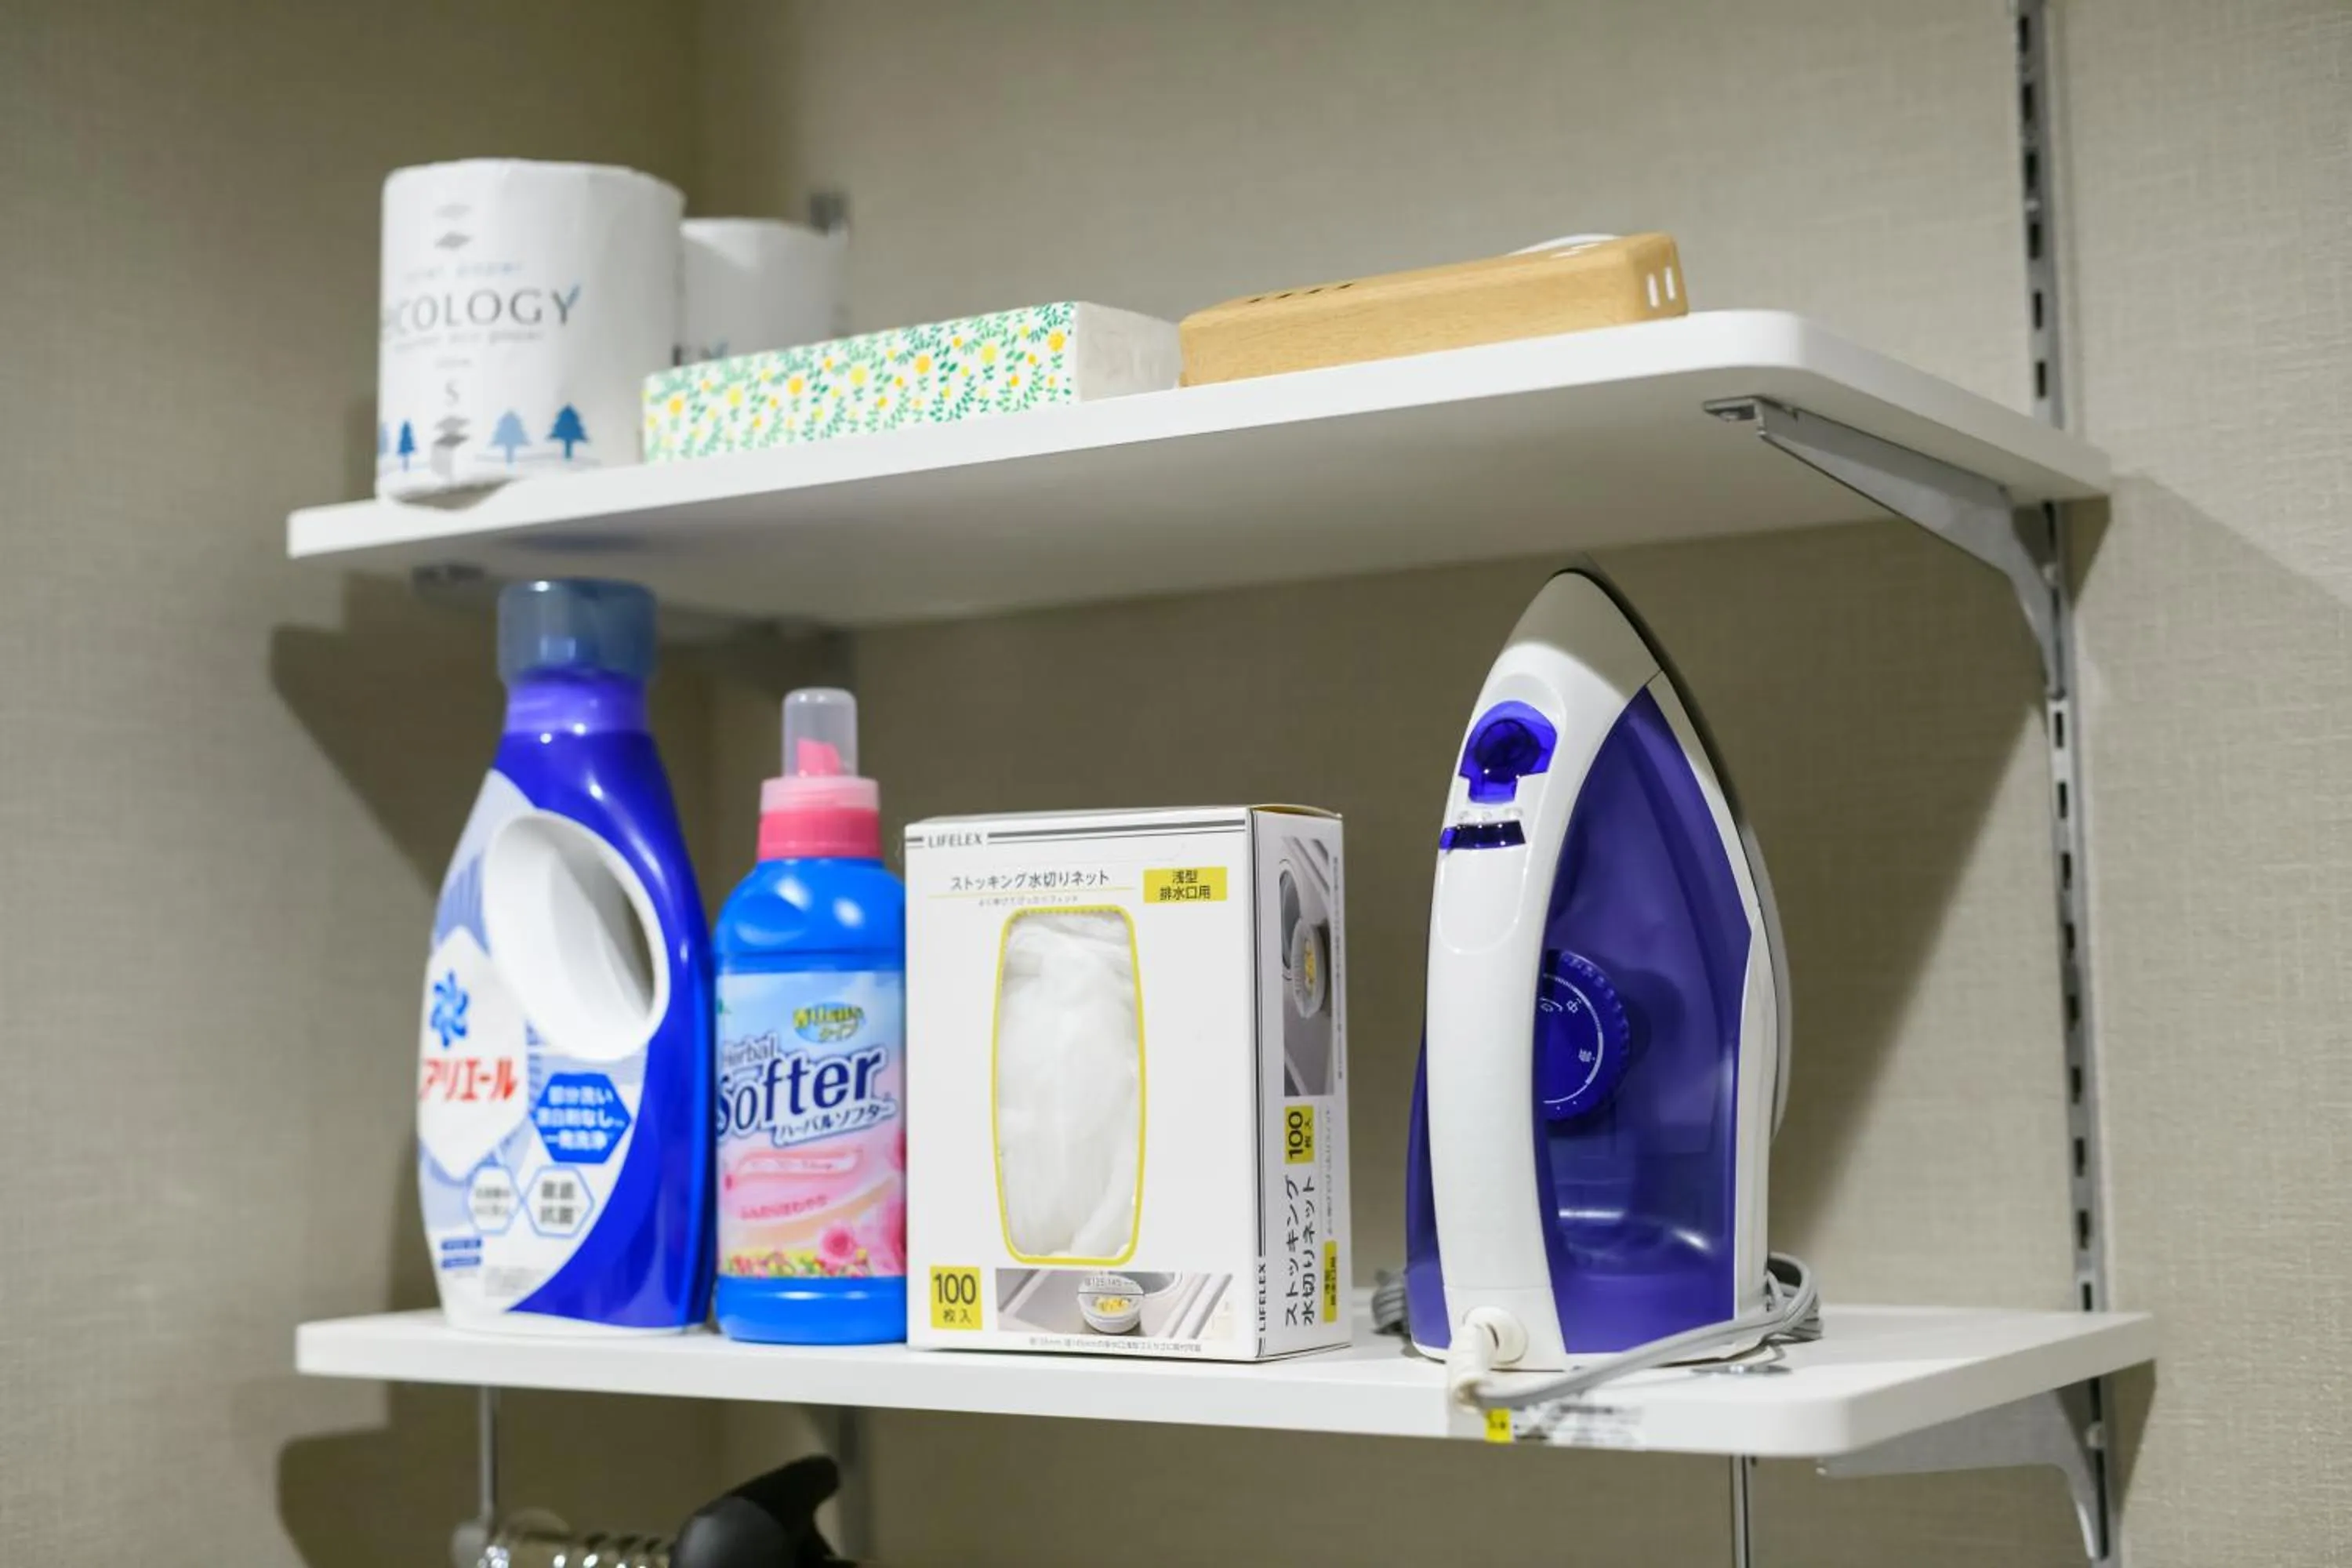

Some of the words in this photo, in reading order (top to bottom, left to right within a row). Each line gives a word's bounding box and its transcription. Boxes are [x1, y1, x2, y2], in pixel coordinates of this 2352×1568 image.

[927, 832, 983, 848] LIFELEX
[950, 869, 1109, 891] ストッキング水切りネット
[1160, 884, 1210, 901] 排水口用
[420, 1058, 517, 1102] アリエール
[1288, 1111, 1304, 1160] 100
[1284, 1174, 1300, 1328] ストッキング
[1301, 1176, 1316, 1326] 水切りネット
[933, 1272, 977, 1305] 100
[1258, 1263, 1267, 1332] LIFELEX
[942, 1309, 972, 1325] 枚入
